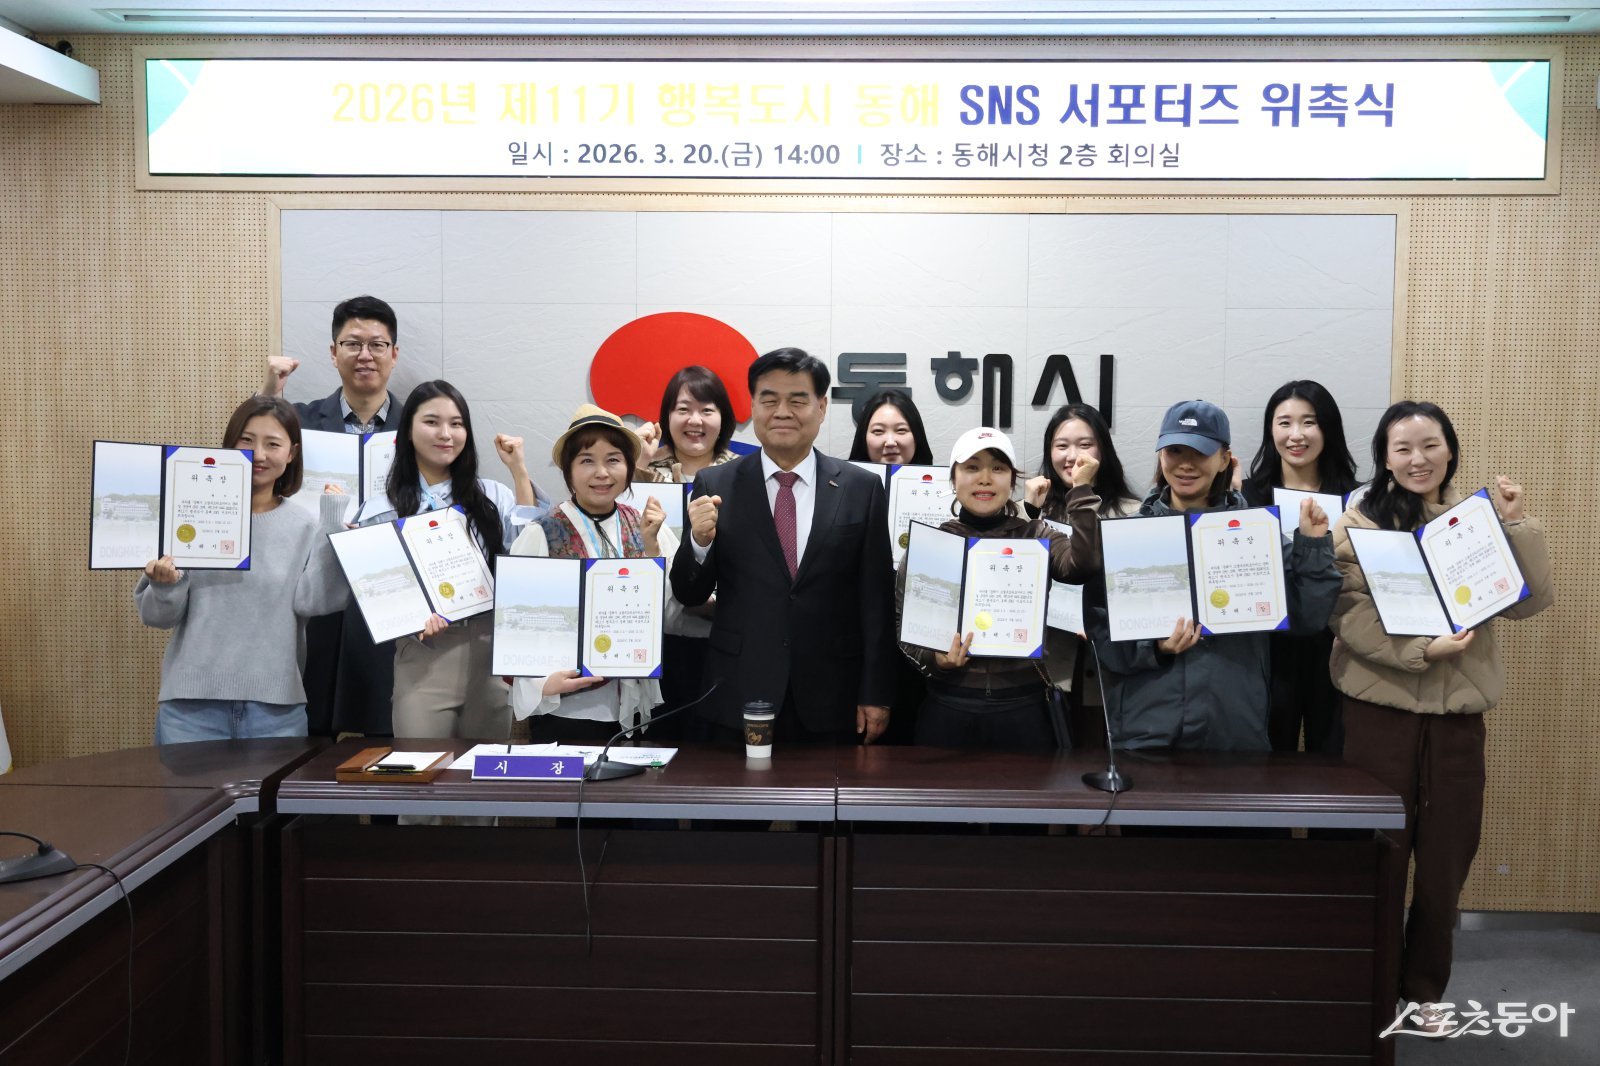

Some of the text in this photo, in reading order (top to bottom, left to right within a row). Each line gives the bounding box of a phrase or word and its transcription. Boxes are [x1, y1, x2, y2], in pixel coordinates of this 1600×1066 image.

[332, 81, 1394, 127] 2026년 제11기 행복도시 동해 SNS 서포터즈 위촉식
[508, 141, 552, 166] 일시
[577, 143, 645, 164] 2026.
[654, 144, 674, 164] 3.
[683, 142, 763, 168] 20.(금)
[774, 144, 841, 165] 14:00
[880, 143, 928, 167] 장소
[952, 143, 1049, 168] 동해시청
[1059, 143, 1098, 168] 2층
[1108, 143, 1180, 168] 회의실
[832, 351, 1114, 428] 동해시
